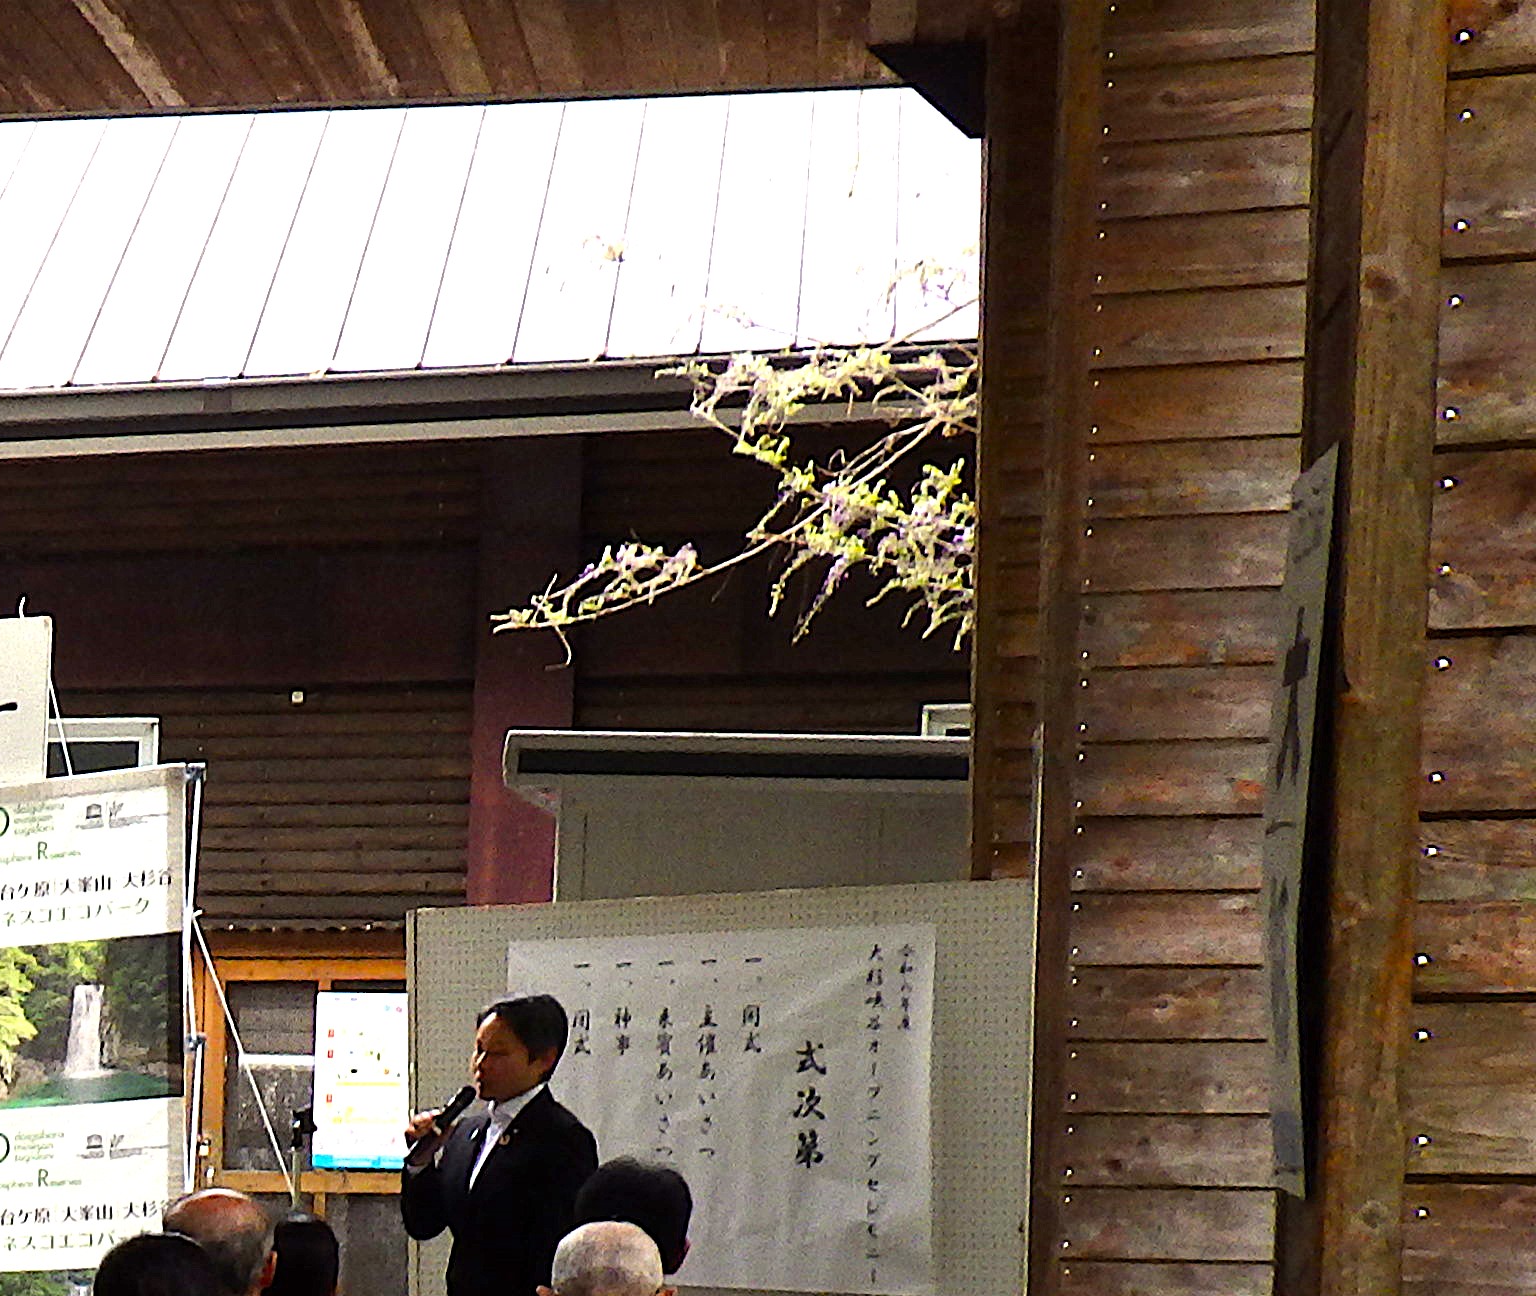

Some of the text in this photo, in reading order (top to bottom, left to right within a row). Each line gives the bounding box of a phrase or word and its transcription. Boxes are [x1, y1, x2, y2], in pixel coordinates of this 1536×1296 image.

[793, 1040, 827, 1169] 式次第
[123, 1200, 167, 1219] 大杉
